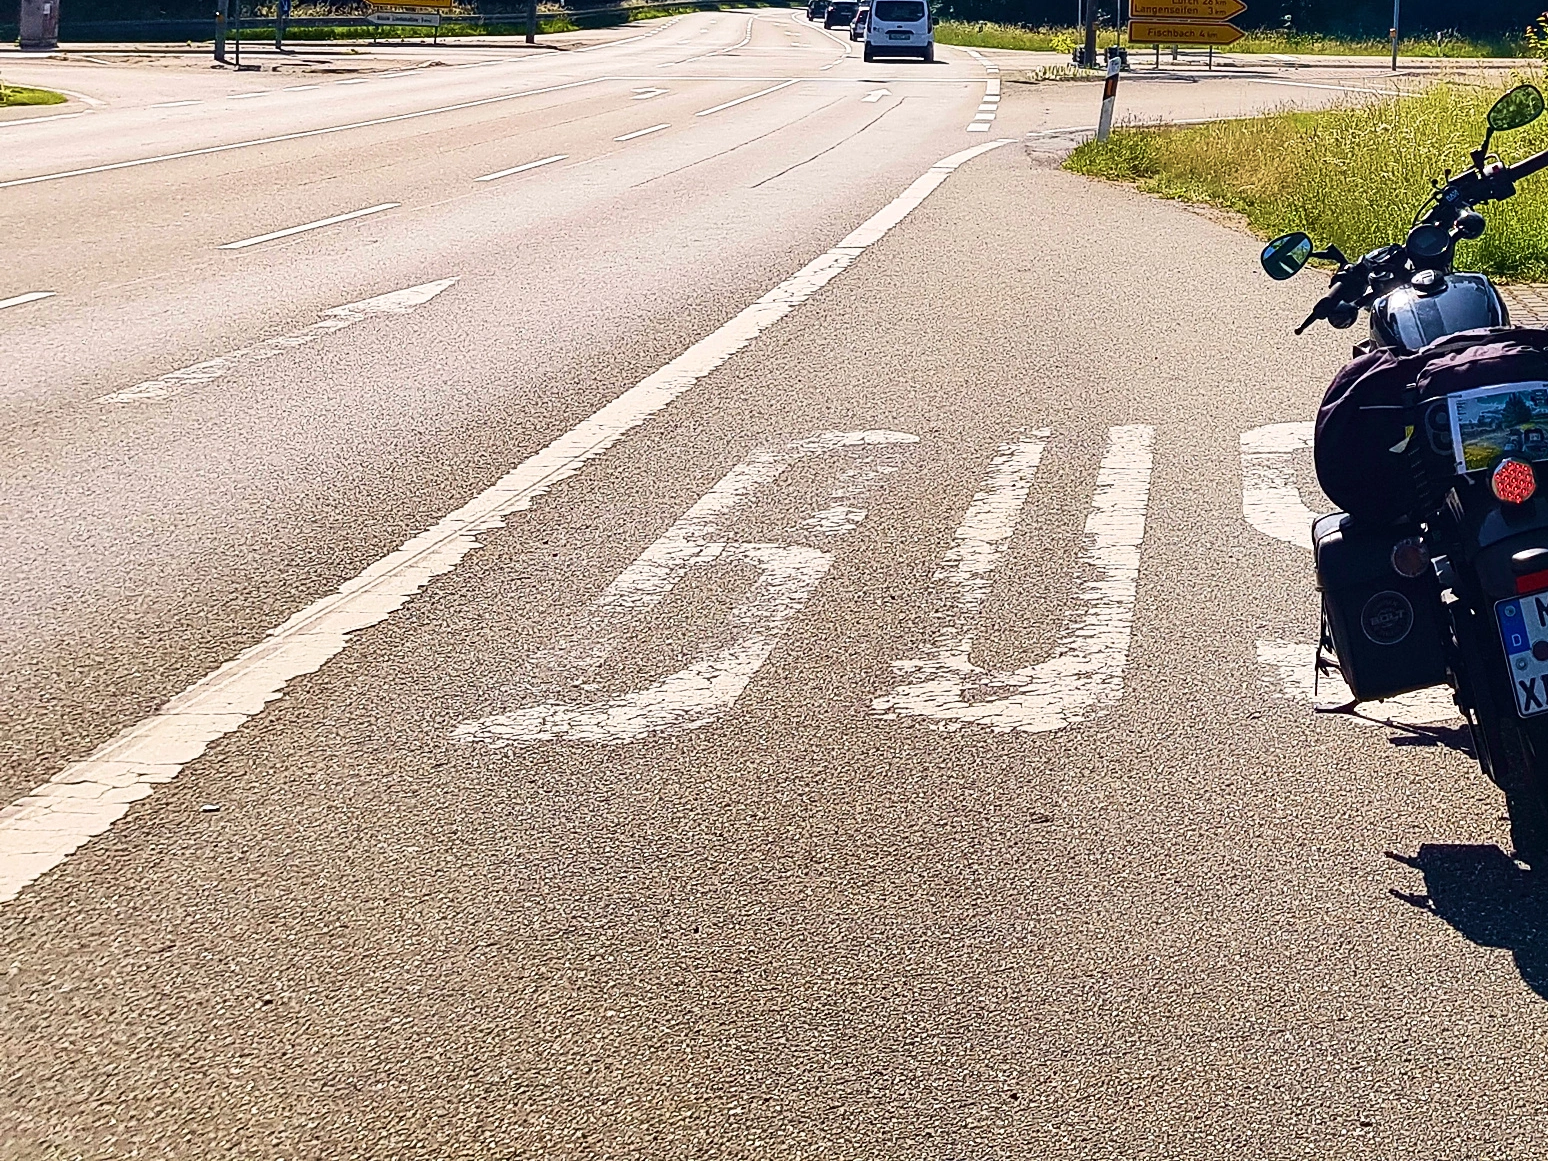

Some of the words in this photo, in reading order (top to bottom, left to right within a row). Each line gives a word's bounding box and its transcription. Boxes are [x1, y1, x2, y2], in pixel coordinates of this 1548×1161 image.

[1134, 5, 1199, 16] Langenseifen
[1208, 7, 1214, 15] 3
[1147, 28, 1195, 38] Fischbach
[1511, 634, 1522, 647] D
